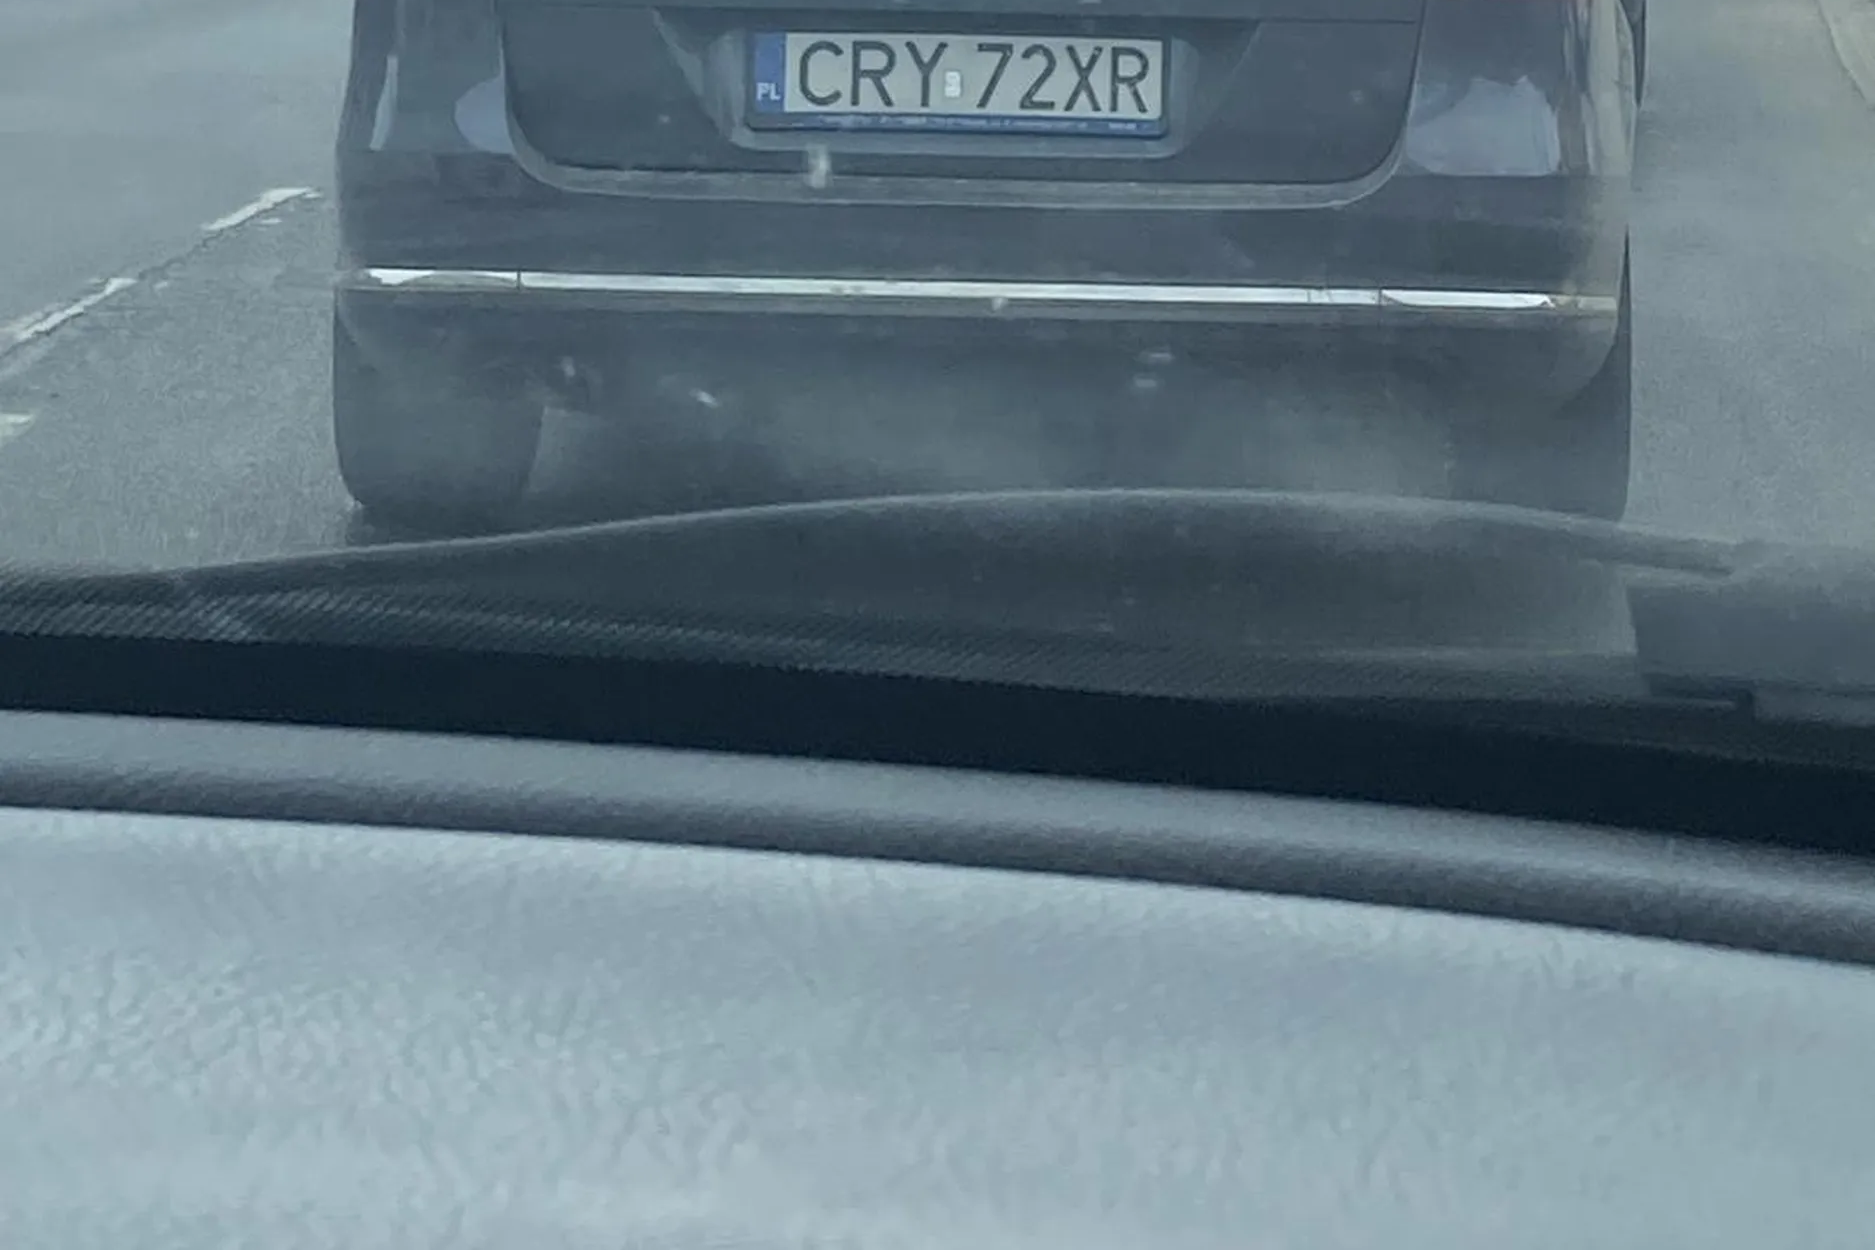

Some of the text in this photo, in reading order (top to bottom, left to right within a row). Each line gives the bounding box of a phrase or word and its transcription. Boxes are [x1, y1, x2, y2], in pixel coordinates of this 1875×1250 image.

[756, 82, 781, 101] PL
[799, 40, 1148, 113] CRY 72XR
